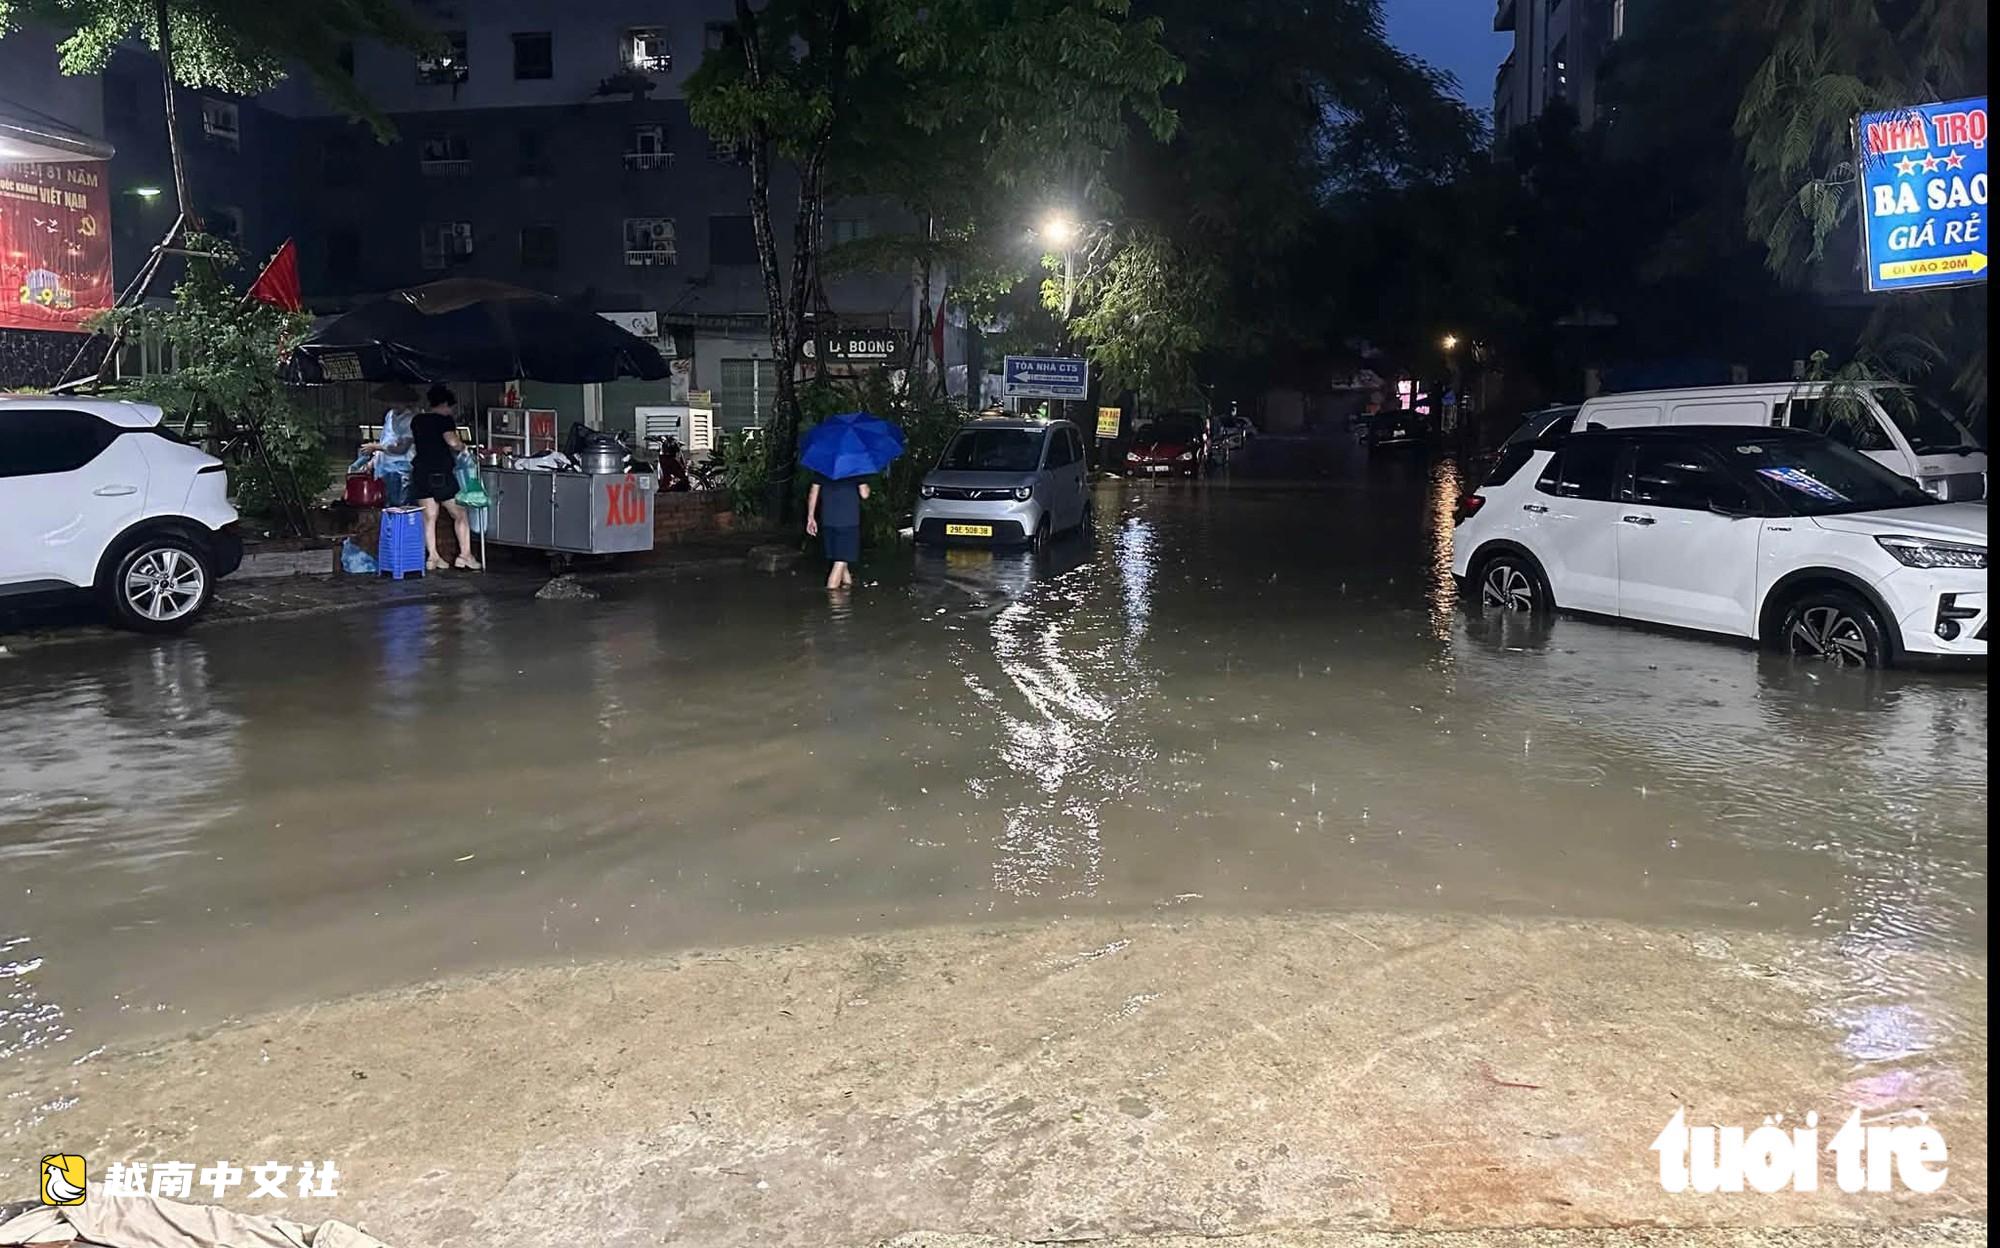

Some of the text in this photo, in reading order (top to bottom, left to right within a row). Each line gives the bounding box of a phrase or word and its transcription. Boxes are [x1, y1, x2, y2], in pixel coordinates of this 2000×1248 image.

[1932, 110, 1987, 149] TRỌ
[66, 168, 98, 188] NĂM
[40, 187, 62, 207] VIỆT
[64, 191, 87, 210] NAM
[1872, 173, 1987, 217] BA SAO
[1888, 212, 1981, 251] GIÁ RẺ
[1941, 258, 1968, 270] 20M
[849, 340, 895, 353] BOONG
